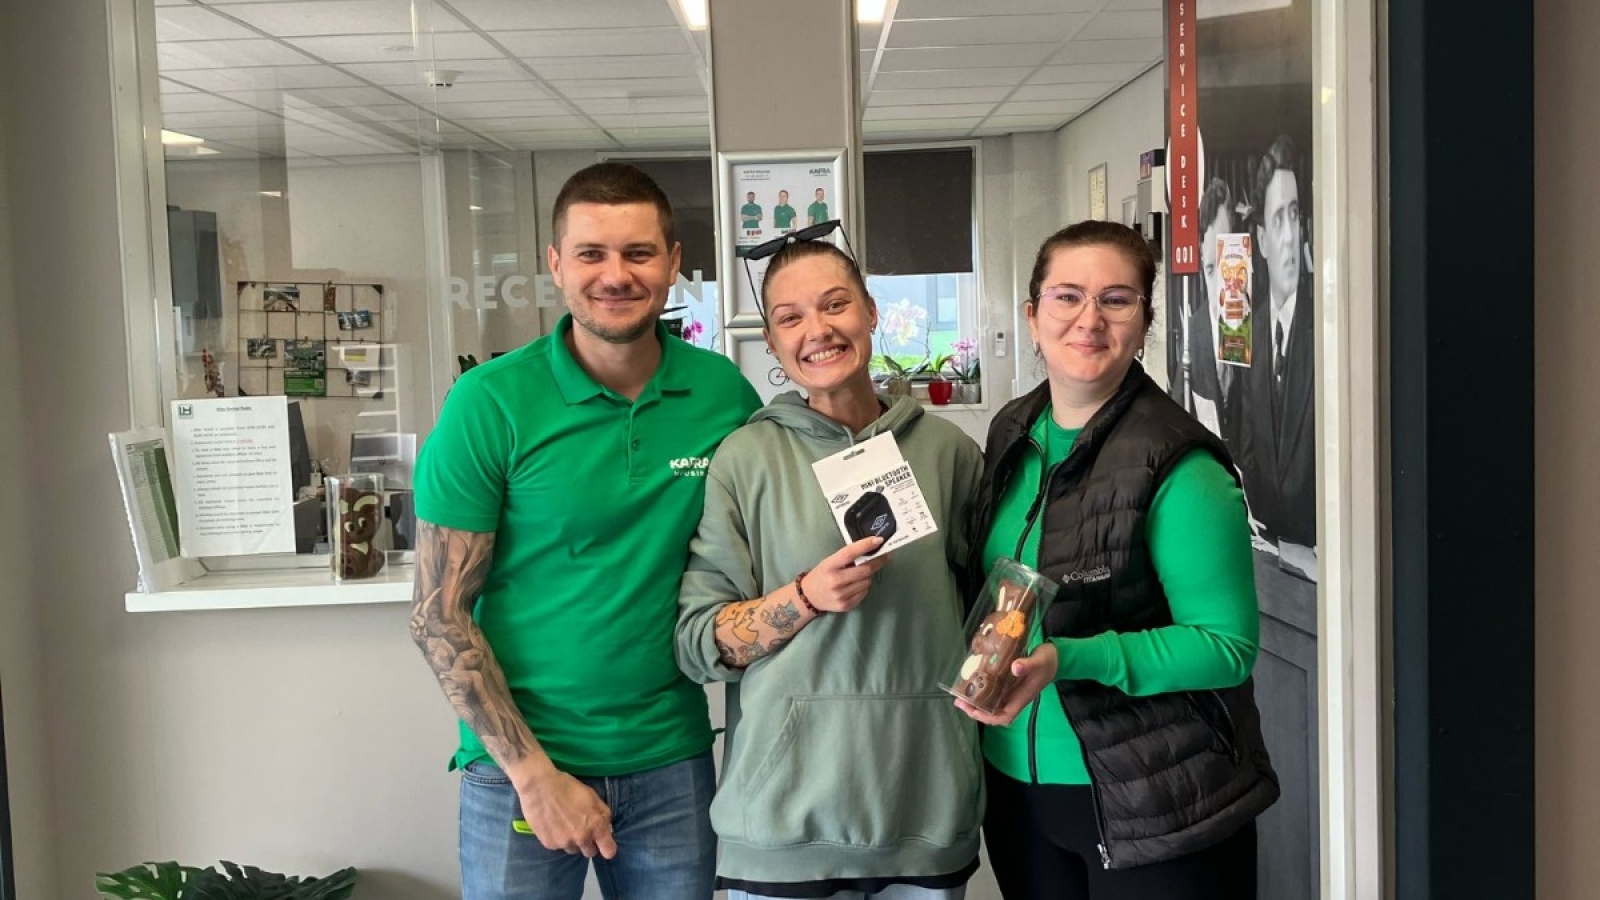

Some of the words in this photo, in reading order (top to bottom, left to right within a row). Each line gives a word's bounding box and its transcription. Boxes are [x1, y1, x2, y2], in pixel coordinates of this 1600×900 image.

[1175, 245, 1193, 264] 001
[669, 456, 709, 469] KAFRA
[861, 480, 874, 490] MINI
[875, 465, 909, 484] BLUETOOTH
[884, 471, 912, 487] SPEAKER
